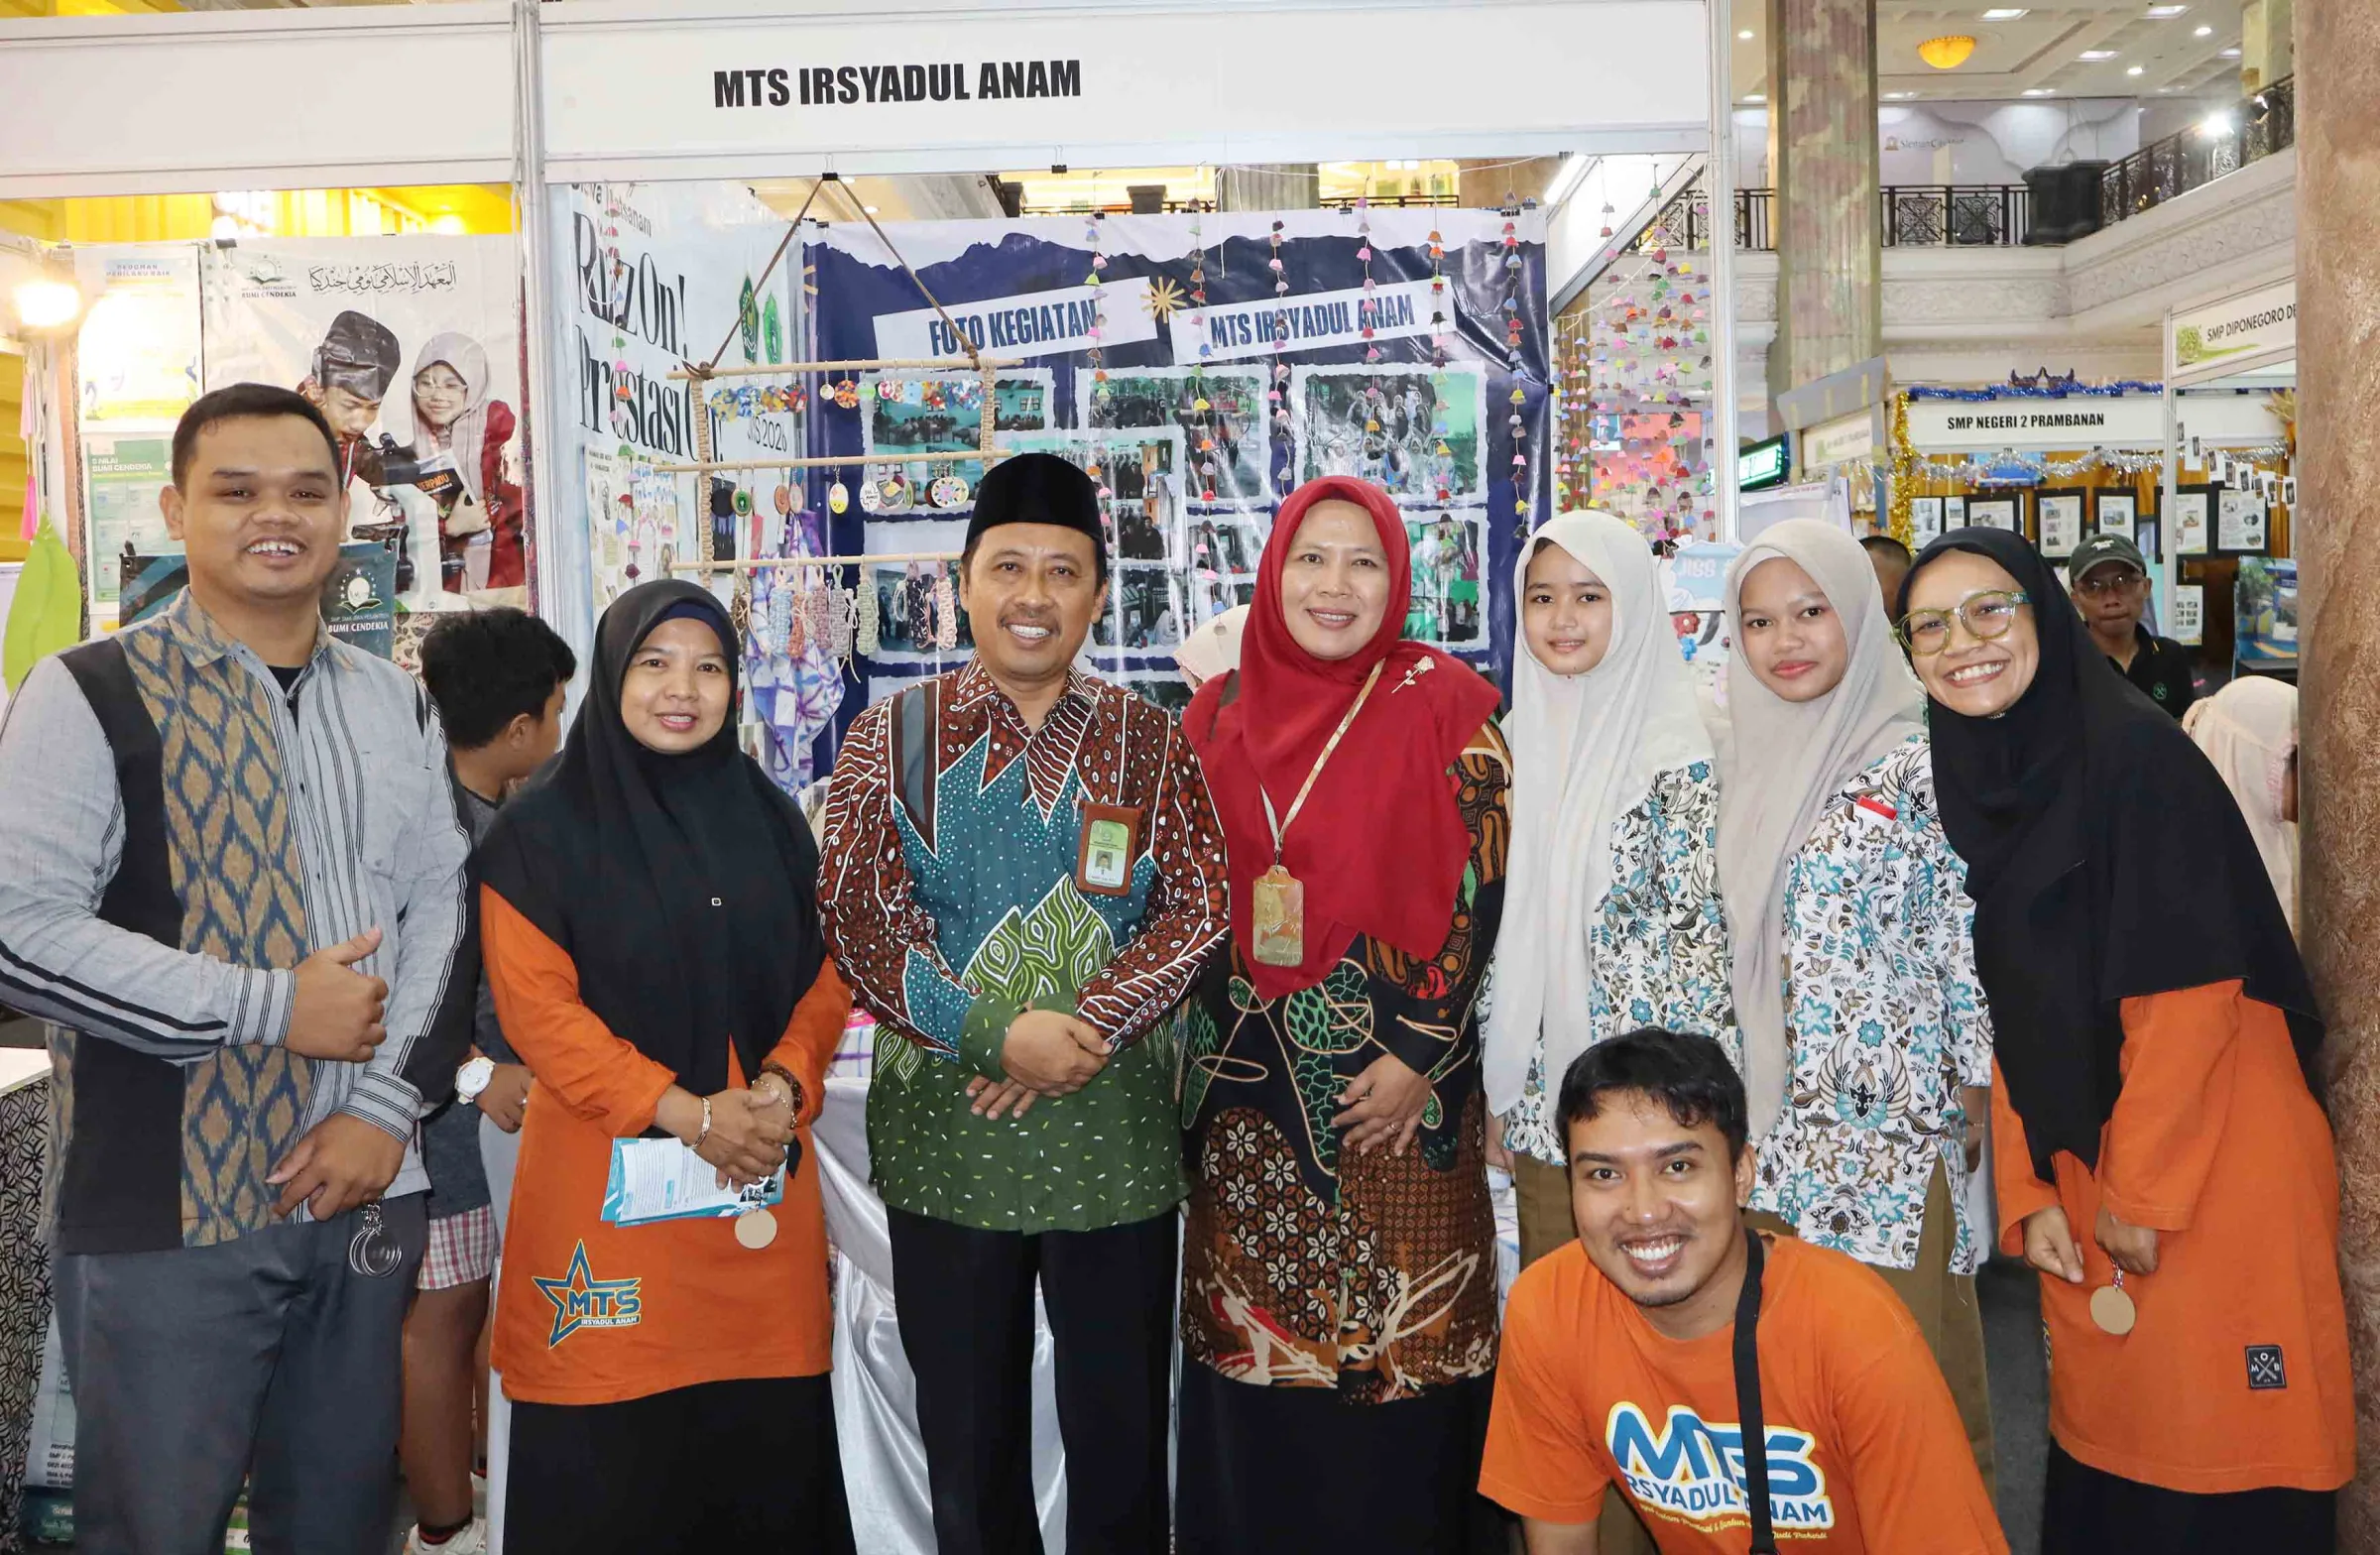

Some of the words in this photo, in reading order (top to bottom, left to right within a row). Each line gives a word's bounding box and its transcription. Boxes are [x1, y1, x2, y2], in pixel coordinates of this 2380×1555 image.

[713, 69, 790, 108] MTS
[799, 62, 970, 105] IRSYADUL
[977, 60, 1082, 100] ANAM
[639, 251, 688, 361] On!
[1210, 311, 1252, 349] MTS
[1253, 303, 1355, 344] IRSYADUL
[1357, 294, 1415, 332] ANAM
[2206, 324, 2224, 342] SMP
[2225, 306, 2285, 337] DIPONEGORO
[928, 313, 987, 357] FOTO
[988, 299, 1095, 347] KEGIATAN
[762, 419, 787, 453] 2026
[1947, 417, 1973, 429] SMP
[1976, 415, 2018, 429] NEGERI
[2020, 415, 2028, 427] 2
[2030, 413, 2104, 427] PRAMBANAN
[327, 623, 350, 633] BUMI
[350, 621, 390, 632] CENDEKIA
[568, 1289, 641, 1316] MTS
[1610, 1408, 1820, 1497] MTS
[1623, 1472, 1738, 1512] RSYADUL
